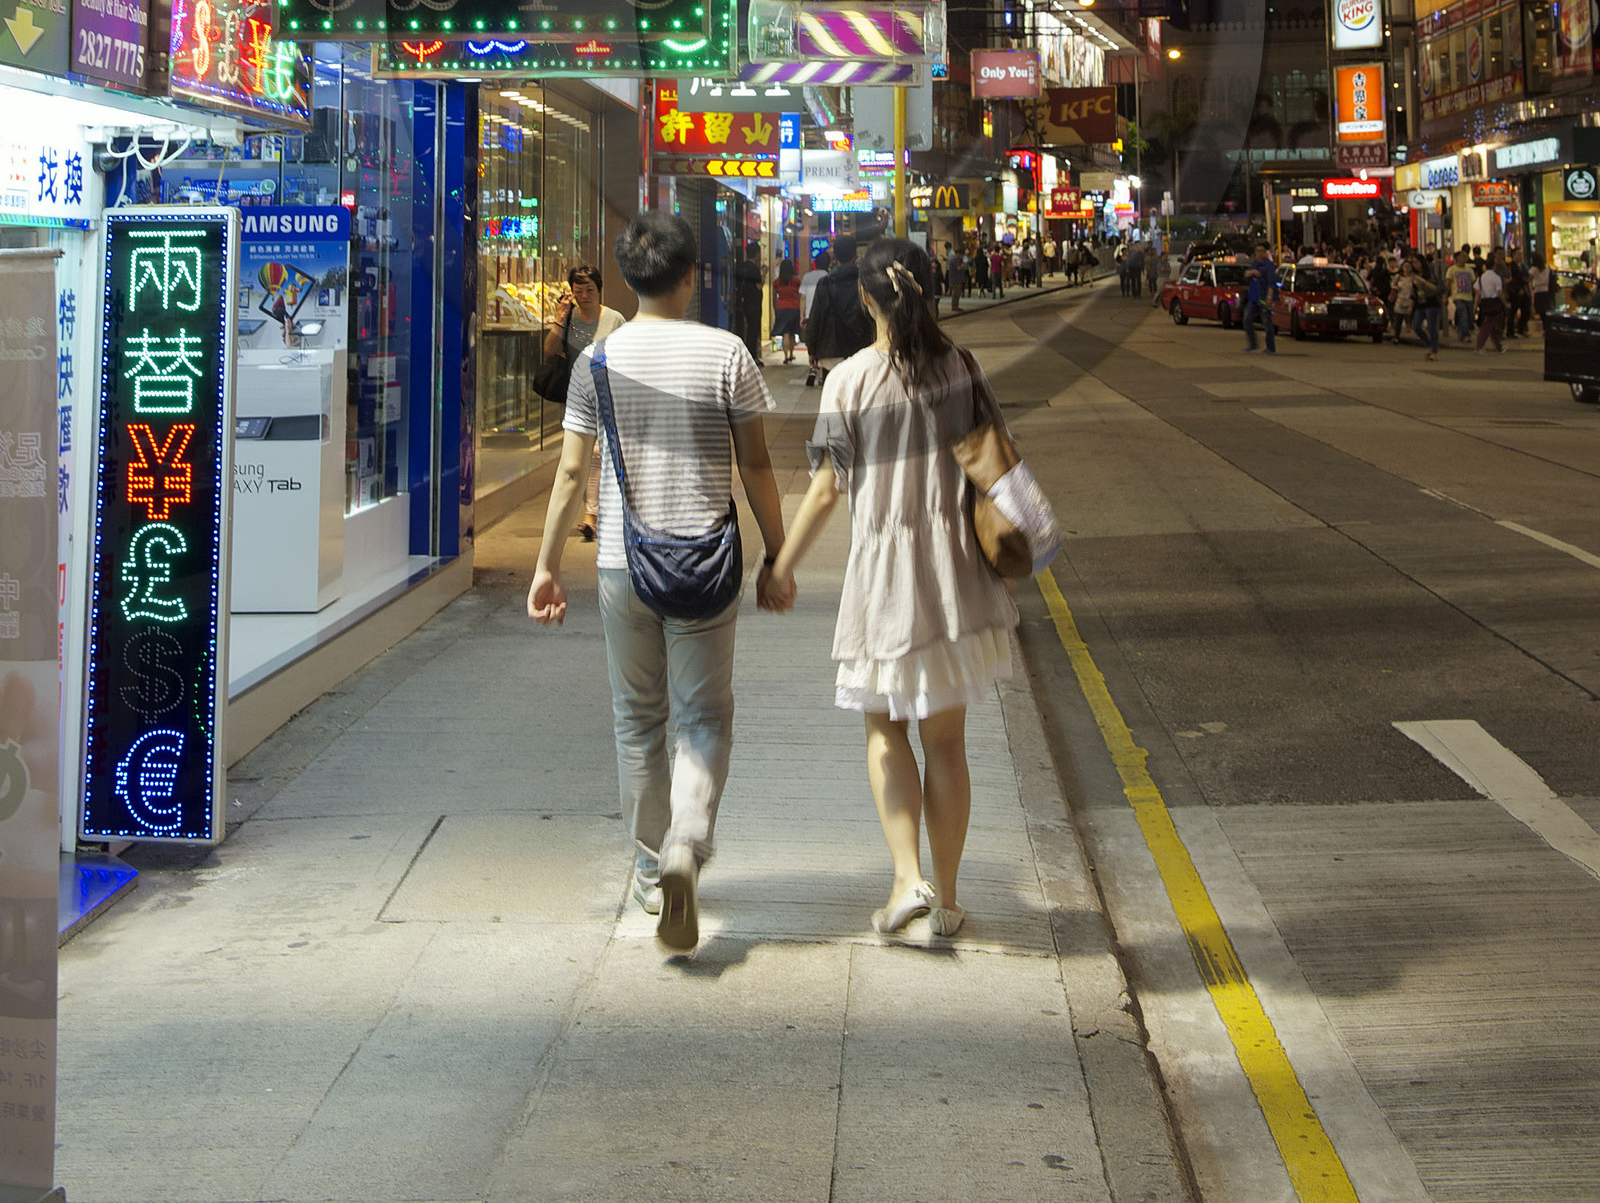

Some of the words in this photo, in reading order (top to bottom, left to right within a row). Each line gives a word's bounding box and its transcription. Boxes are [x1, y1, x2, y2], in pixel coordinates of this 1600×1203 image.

[129, 2, 148, 27] Salon
[1343, 1, 1374, 24] KING
[79, 28, 112, 71] 2827
[113, 37, 145, 79] 7775
[981, 65, 1006, 80] Only
[1008, 65, 1028, 78] You
[1060, 94, 1112, 123] KFC
[660, 109, 773, 146] 許留山
[38, 145, 83, 206] 找換
[805, 167, 842, 177] PREME
[233, 463, 265, 480] sung
[233, 479, 263, 493] AXY
[267, 479, 302, 492] Tab
